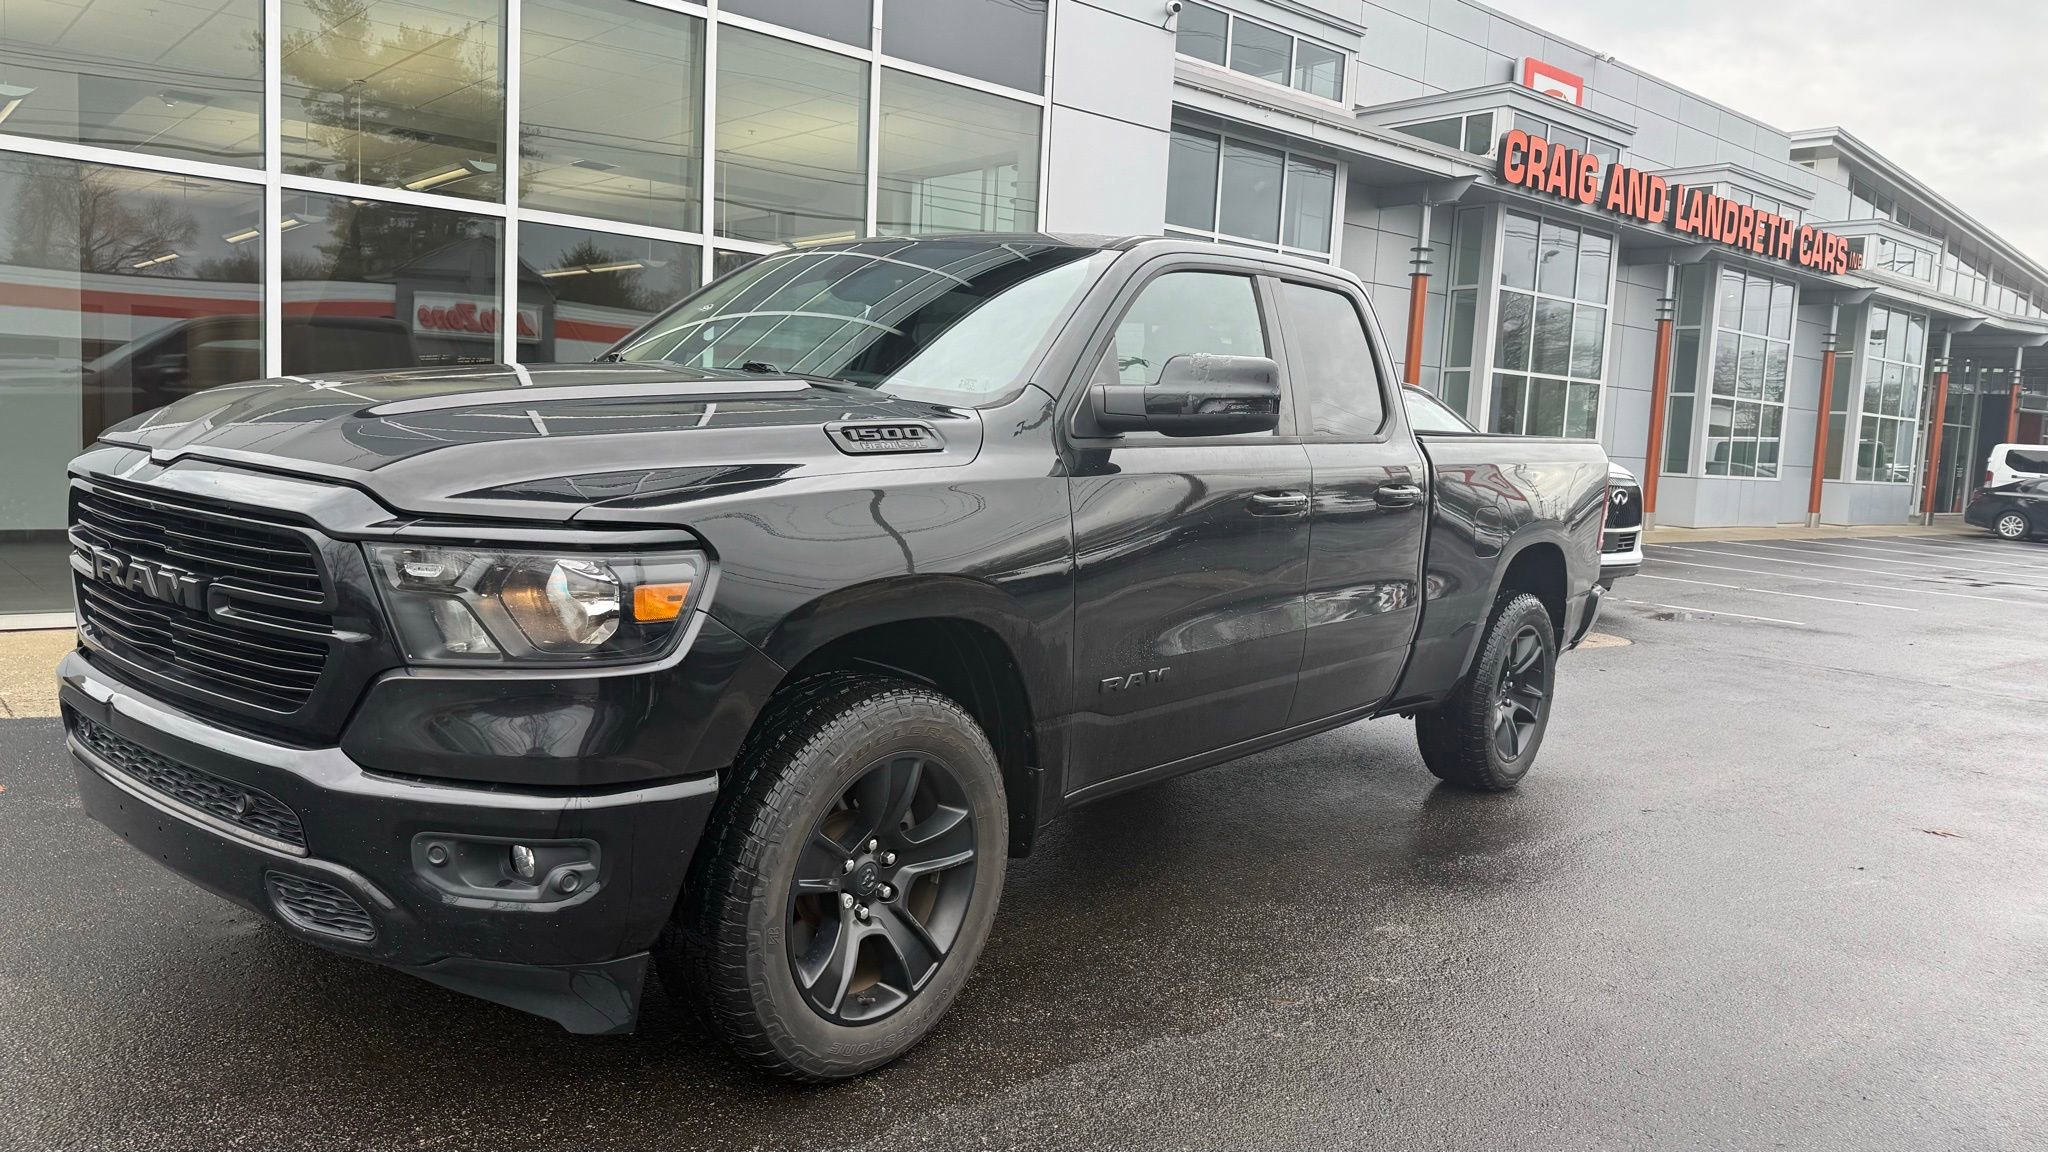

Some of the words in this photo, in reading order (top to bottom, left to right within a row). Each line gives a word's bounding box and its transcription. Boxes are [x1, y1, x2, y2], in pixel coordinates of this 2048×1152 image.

[1502, 129, 1600, 205] CRAIG
[1606, 162, 1667, 223] AND
[1673, 183, 1795, 260] LANDRETH
[1799, 223, 1849, 275] CARS
[844, 427, 924, 440] 1500
[861, 440, 897, 450] HEMI
[94, 549, 203, 611] RAM
[1100, 666, 1171, 694] RAM
